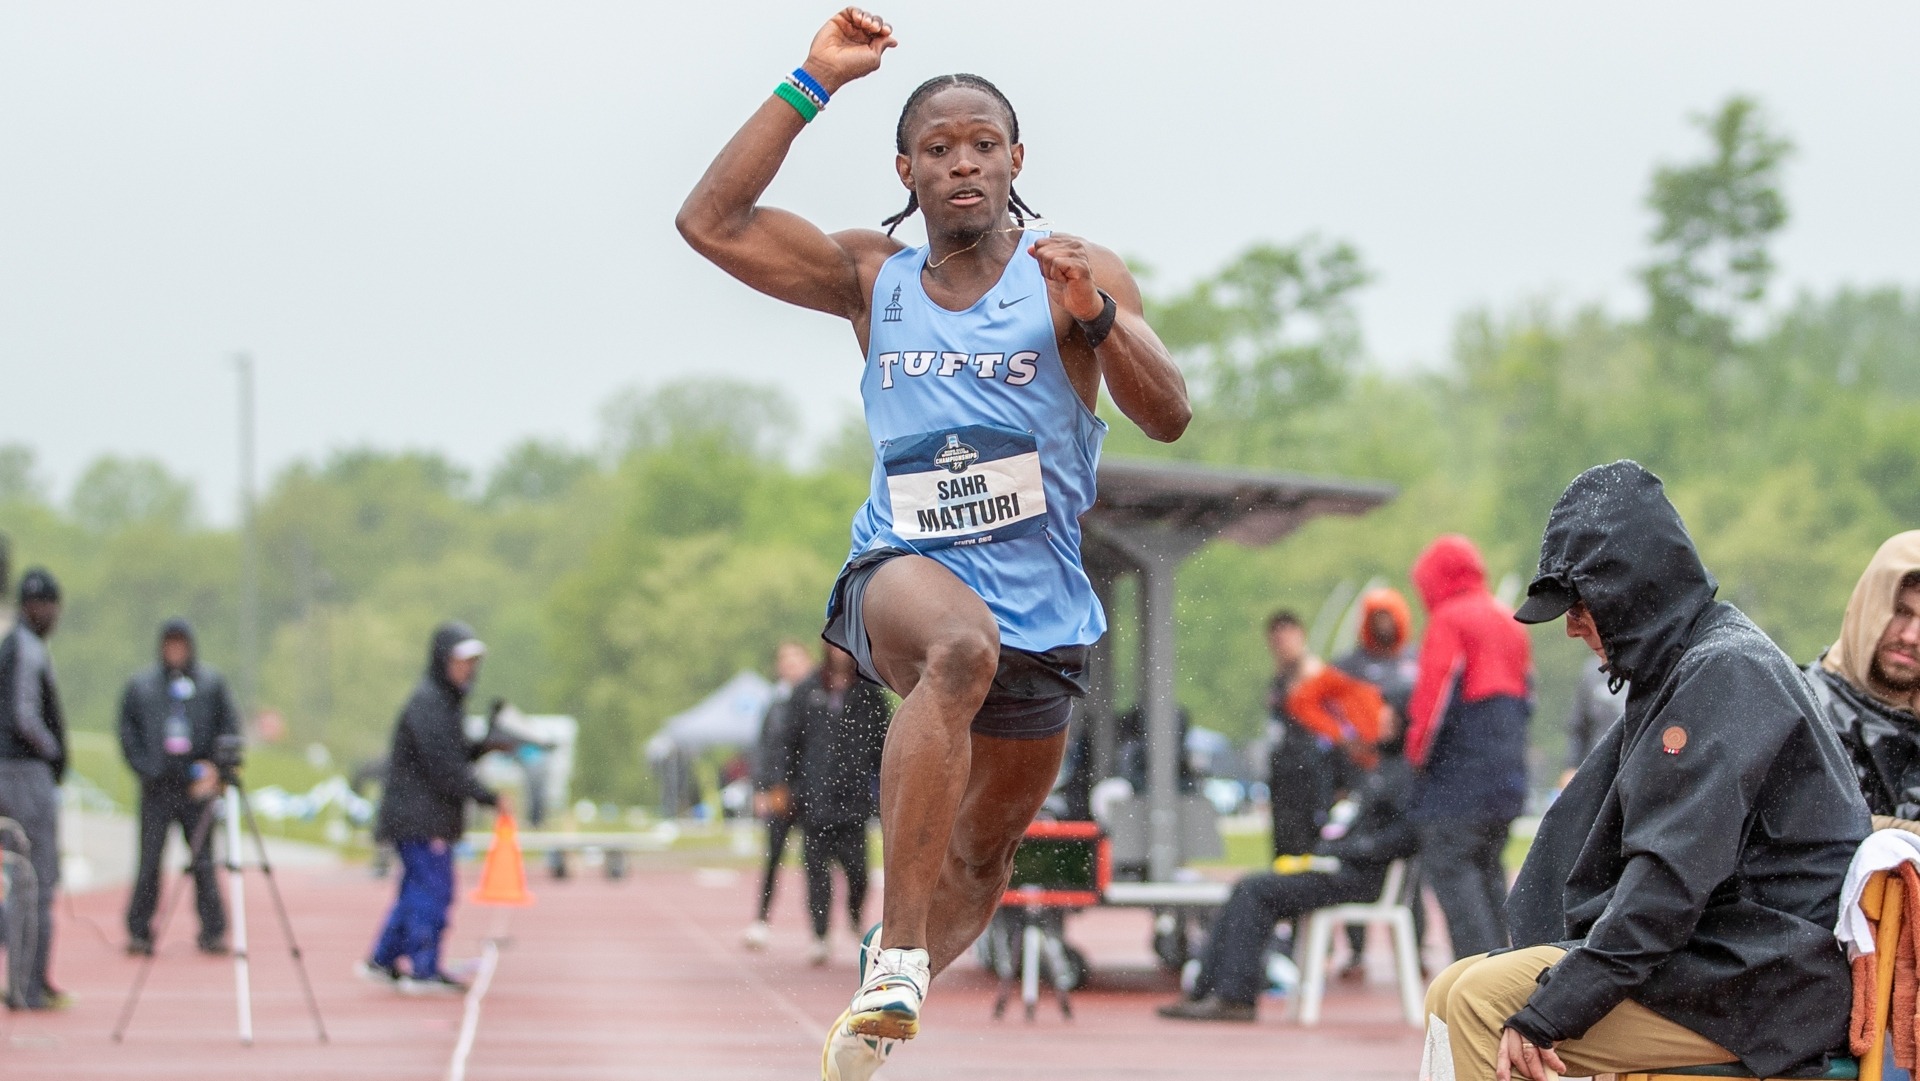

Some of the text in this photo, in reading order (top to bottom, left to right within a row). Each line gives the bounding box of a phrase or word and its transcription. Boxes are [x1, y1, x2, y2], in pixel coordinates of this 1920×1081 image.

[879, 350, 1041, 390] TUFTS
[937, 474, 988, 500] SAHR
[916, 492, 1020, 532] MATTURI
